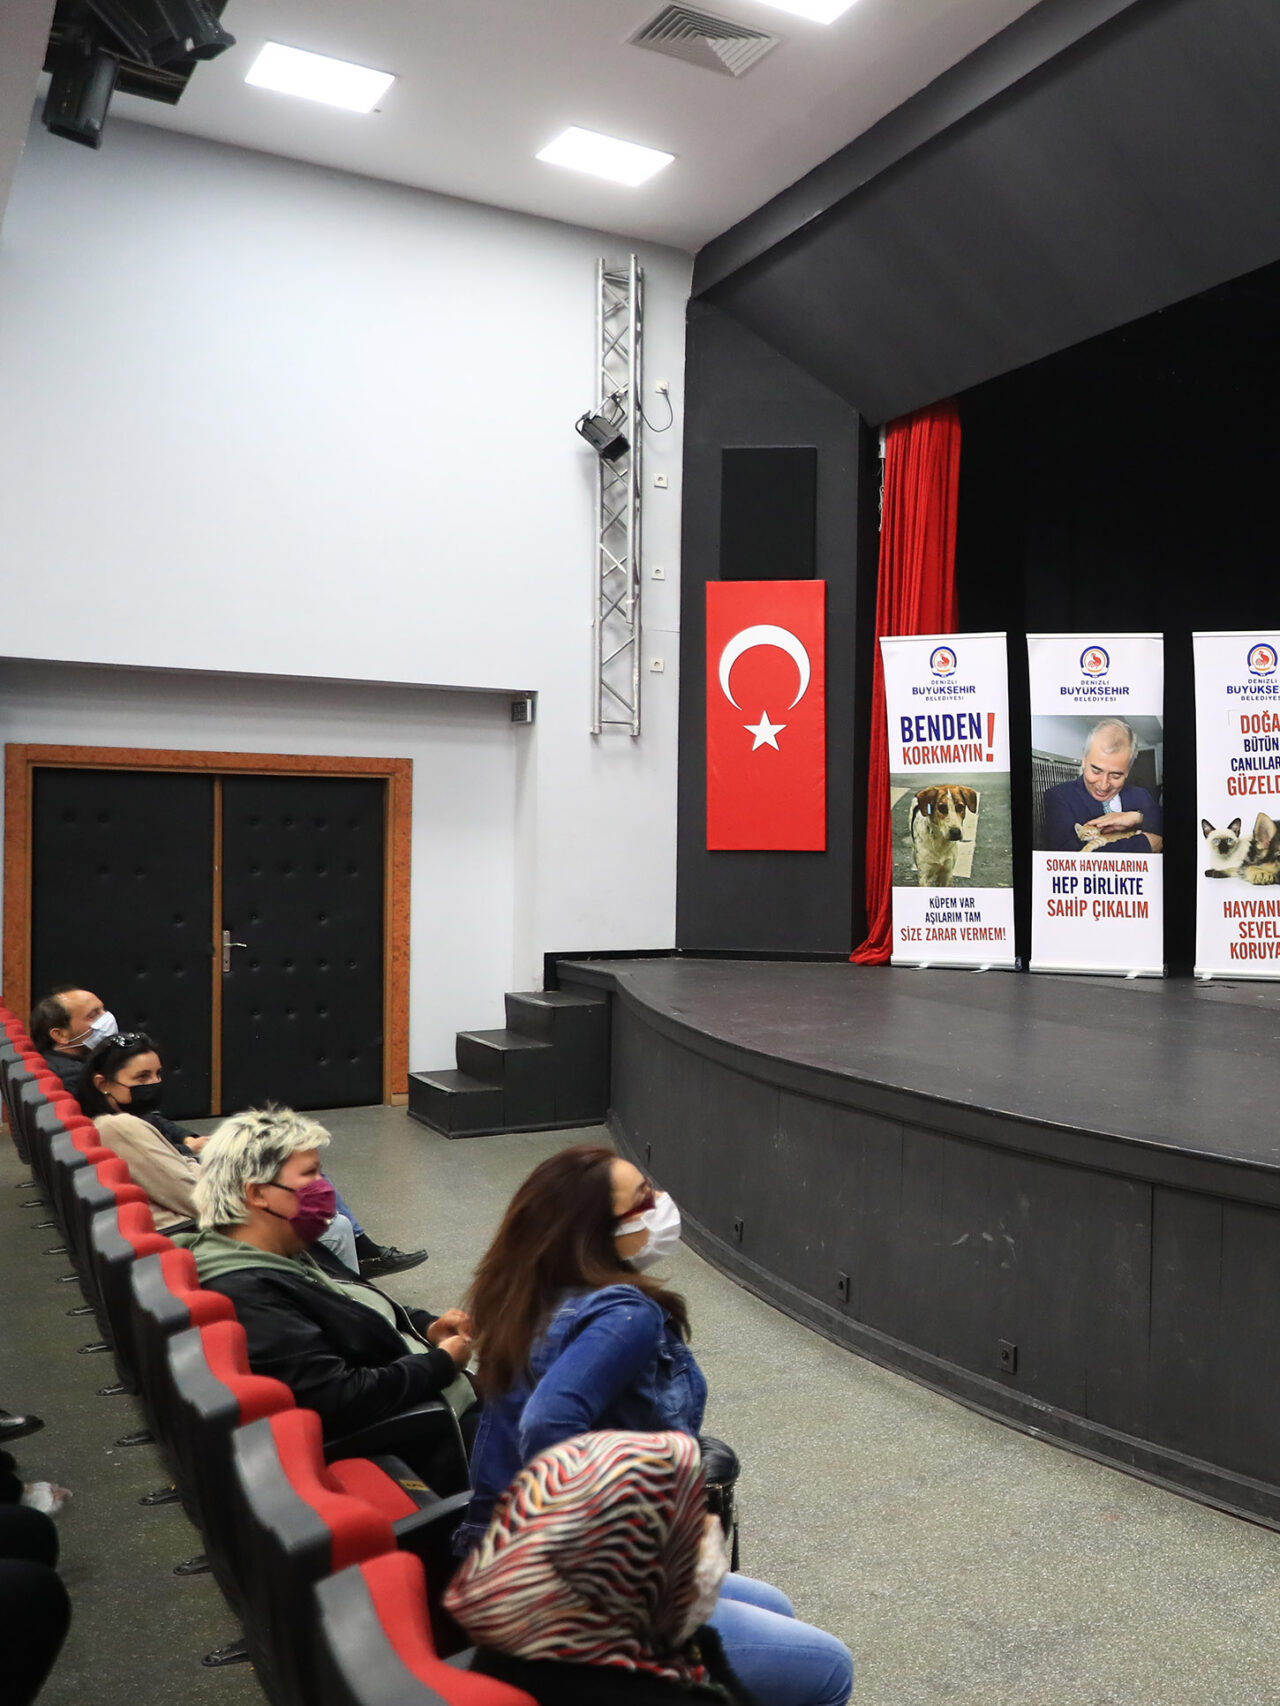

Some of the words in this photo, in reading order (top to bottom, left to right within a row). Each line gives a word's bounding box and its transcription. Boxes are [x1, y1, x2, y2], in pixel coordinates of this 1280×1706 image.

[900, 712, 982, 743] BENDEN
[1240, 710, 1280, 734] DOĞA
[1243, 735, 1280, 752] BÜTÜN
[902, 743, 983, 765] KORKMAYIN
[1046, 859, 1077, 871] SOKAK
[1079, 859, 1149, 872] HAYVANLARINA
[1052, 876, 1079, 894] HEP
[1083, 873, 1144, 895] BİRLİKTE
[929, 895, 957, 909] KÜPEM
[959, 897, 975, 908] VAR
[1047, 896, 1088, 917] SAHİP
[1092, 900, 1149, 921] ÇIKALIM
[925, 911, 963, 925] AŞILARIM
[964, 911, 982, 923] TAM
[900, 925, 922, 942] SİZE
[926, 927, 957, 941] ZARAR
[960, 927, 1007, 941] VERMEM!
